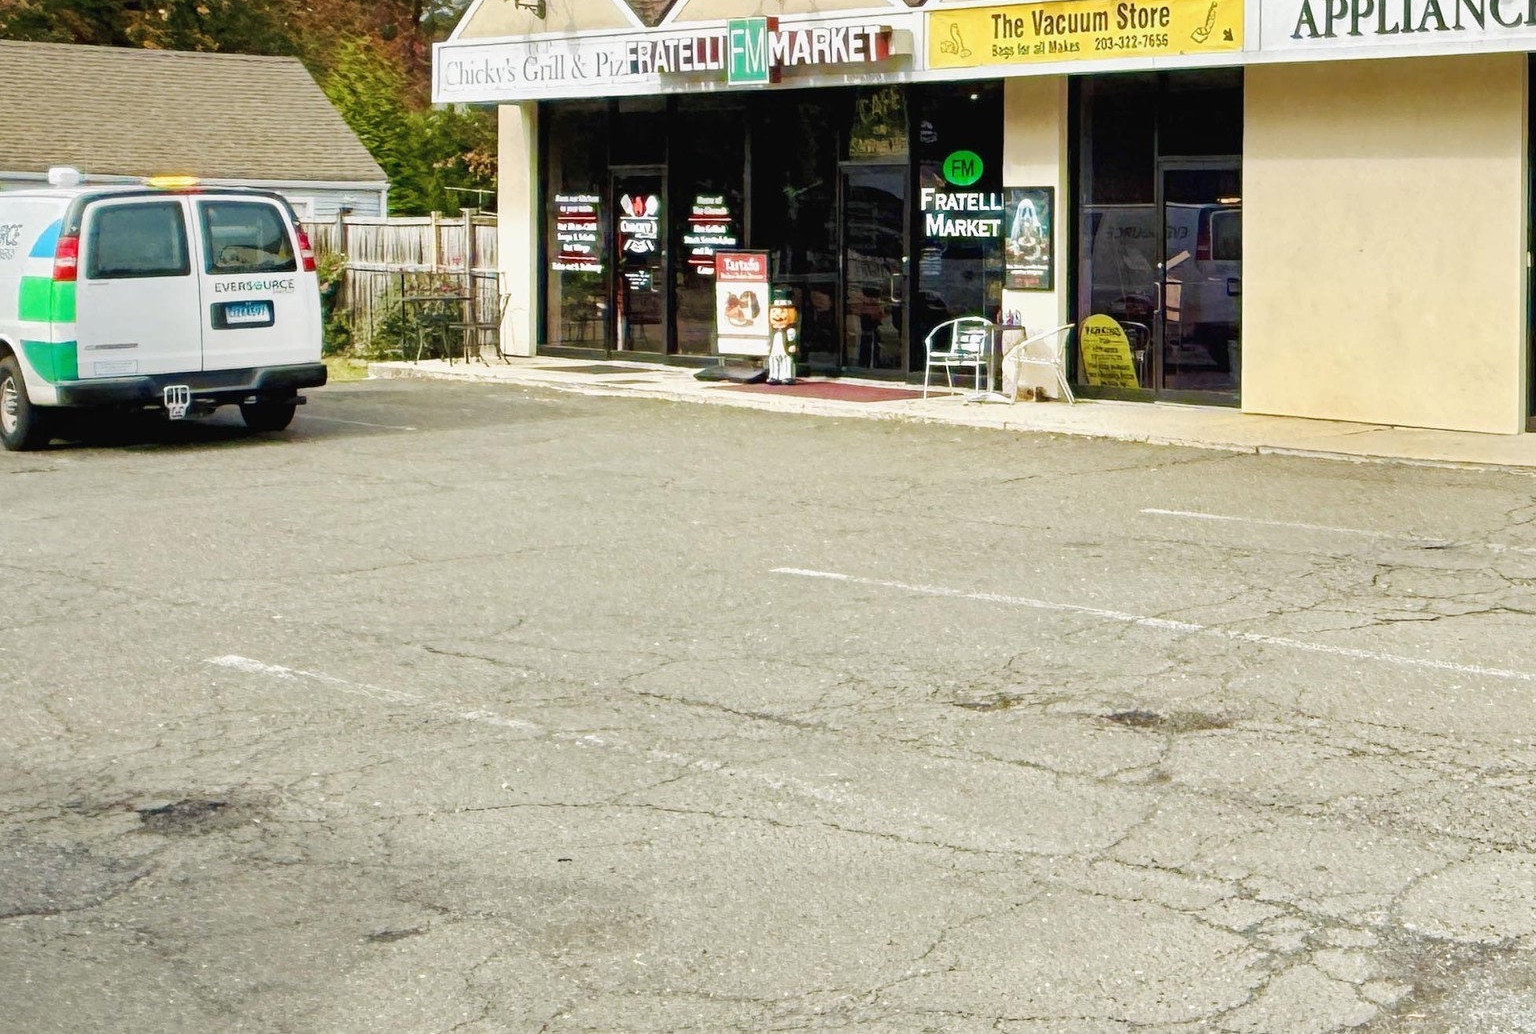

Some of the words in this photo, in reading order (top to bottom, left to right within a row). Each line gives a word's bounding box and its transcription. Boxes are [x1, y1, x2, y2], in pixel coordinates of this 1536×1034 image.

[992, 13, 1024, 39] The
[1032, 9, 1108, 36] Vacuum
[1117, 2, 1170, 30] Store
[626, 35, 727, 74] FRATELLI
[731, 27, 766, 74] FM
[768, 25, 881, 66] MARKET
[992, 44, 1014, 59] Bags
[1018, 43, 1030, 55] for
[1033, 42, 1045, 54] all
[1049, 40, 1080, 53] Makes
[446, 58, 516, 86] Chicky's
[523, 55, 565, 82] Grill
[571, 54, 588, 79] &
[596, 52, 627, 78] Piz
[952, 159, 974, 177] FM
[926, 214, 1001, 237] MARKET
[214, 278, 295, 293] EVERSOURCE
